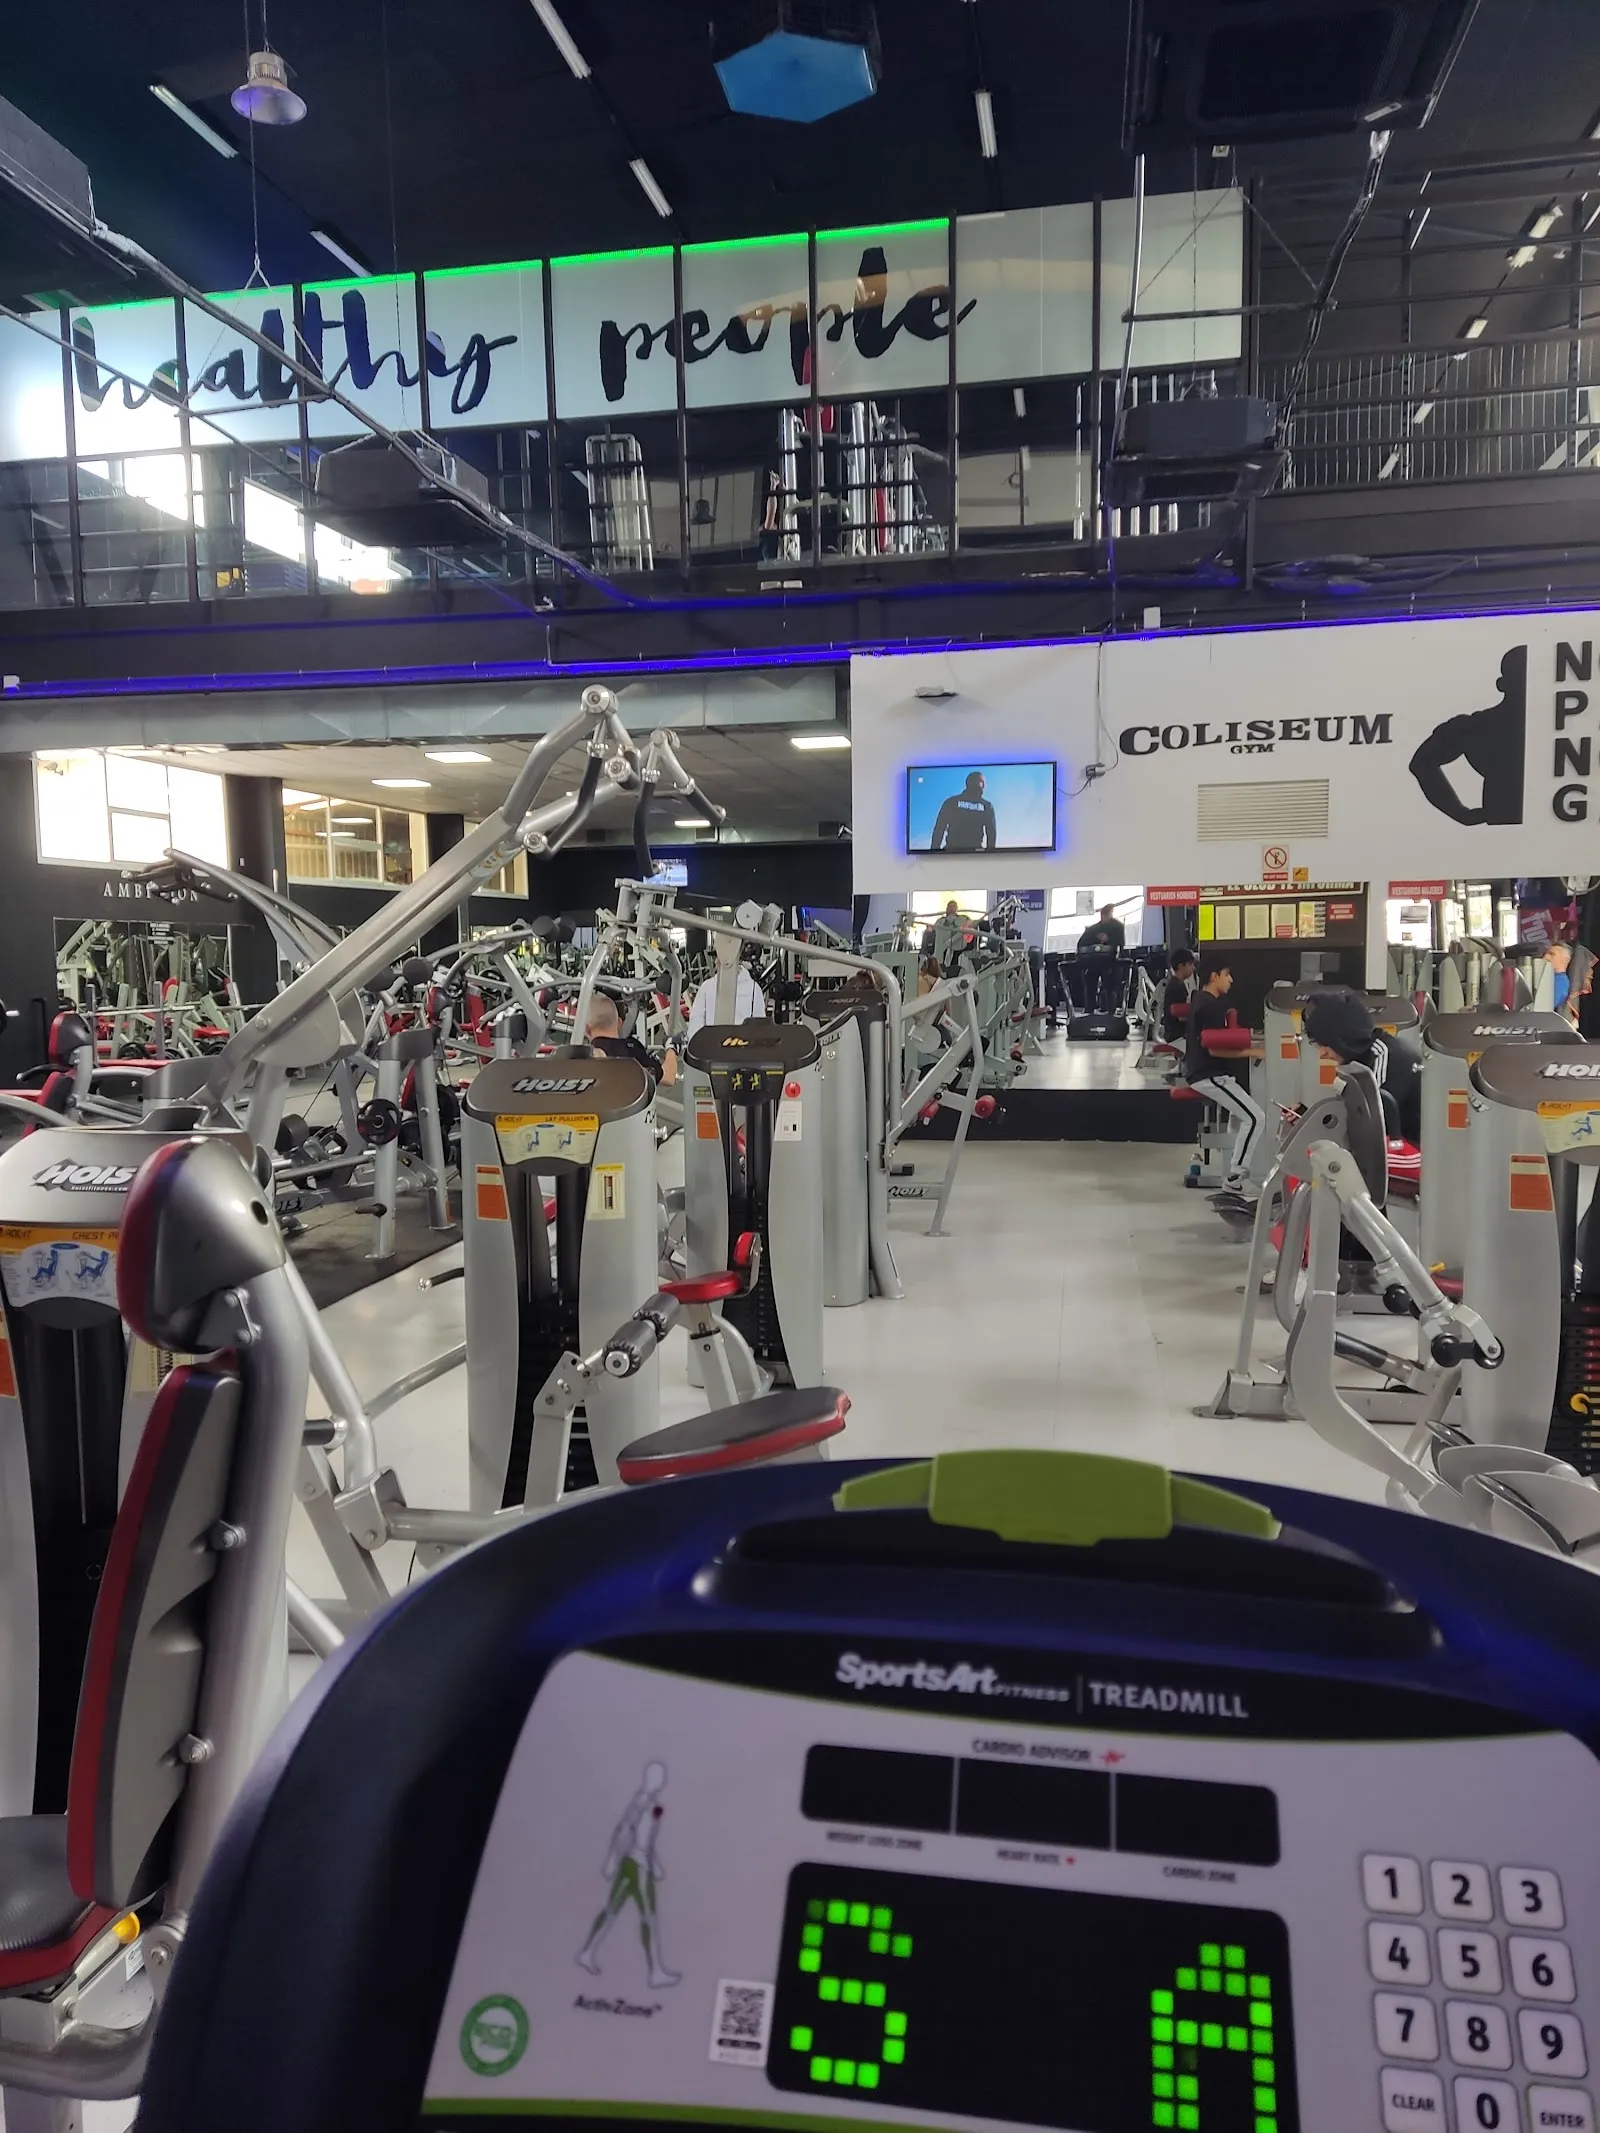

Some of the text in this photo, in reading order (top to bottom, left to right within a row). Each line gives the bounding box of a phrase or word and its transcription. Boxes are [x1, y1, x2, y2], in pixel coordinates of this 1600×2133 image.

[73, 247, 977, 414] healthy people
[1119, 713, 1393, 756] COLISEUM
[1230, 743, 1275, 755] GYM
[513, 1078, 595, 1091] HOIST
[1543, 1063, 1600, 1077] HOI
[36, 1164, 139, 1185] HOIS
[72, 1231, 104, 1240] CHEST
[836, 1652, 998, 1696] SportsArt
[1089, 1682, 1249, 1718] TREADMILL
[972, 1737, 1091, 1762] CARDIO ADVISOR
[1383, 1867, 1398, 1899] 1
[1451, 1873, 1473, 1907] 2
[1520, 1880, 1543, 1913] 3
[1388, 1937, 1410, 1971] 4
[1460, 1944, 1481, 1978] 5
[1532, 1952, 1554, 1987] 6
[790, 1898, 913, 2090] S
[1150, 1942, 1278, 2133] A
[1396, 2007, 1415, 2043] 7
[1467, 2016, 1490, 2052] 8
[1540, 2024, 1564, 2060] 9
[1391, 2093, 1435, 2113] CLEAR
[1476, 2092, 1500, 2130] 0
[1540, 2111, 1585, 2129] ENTER
